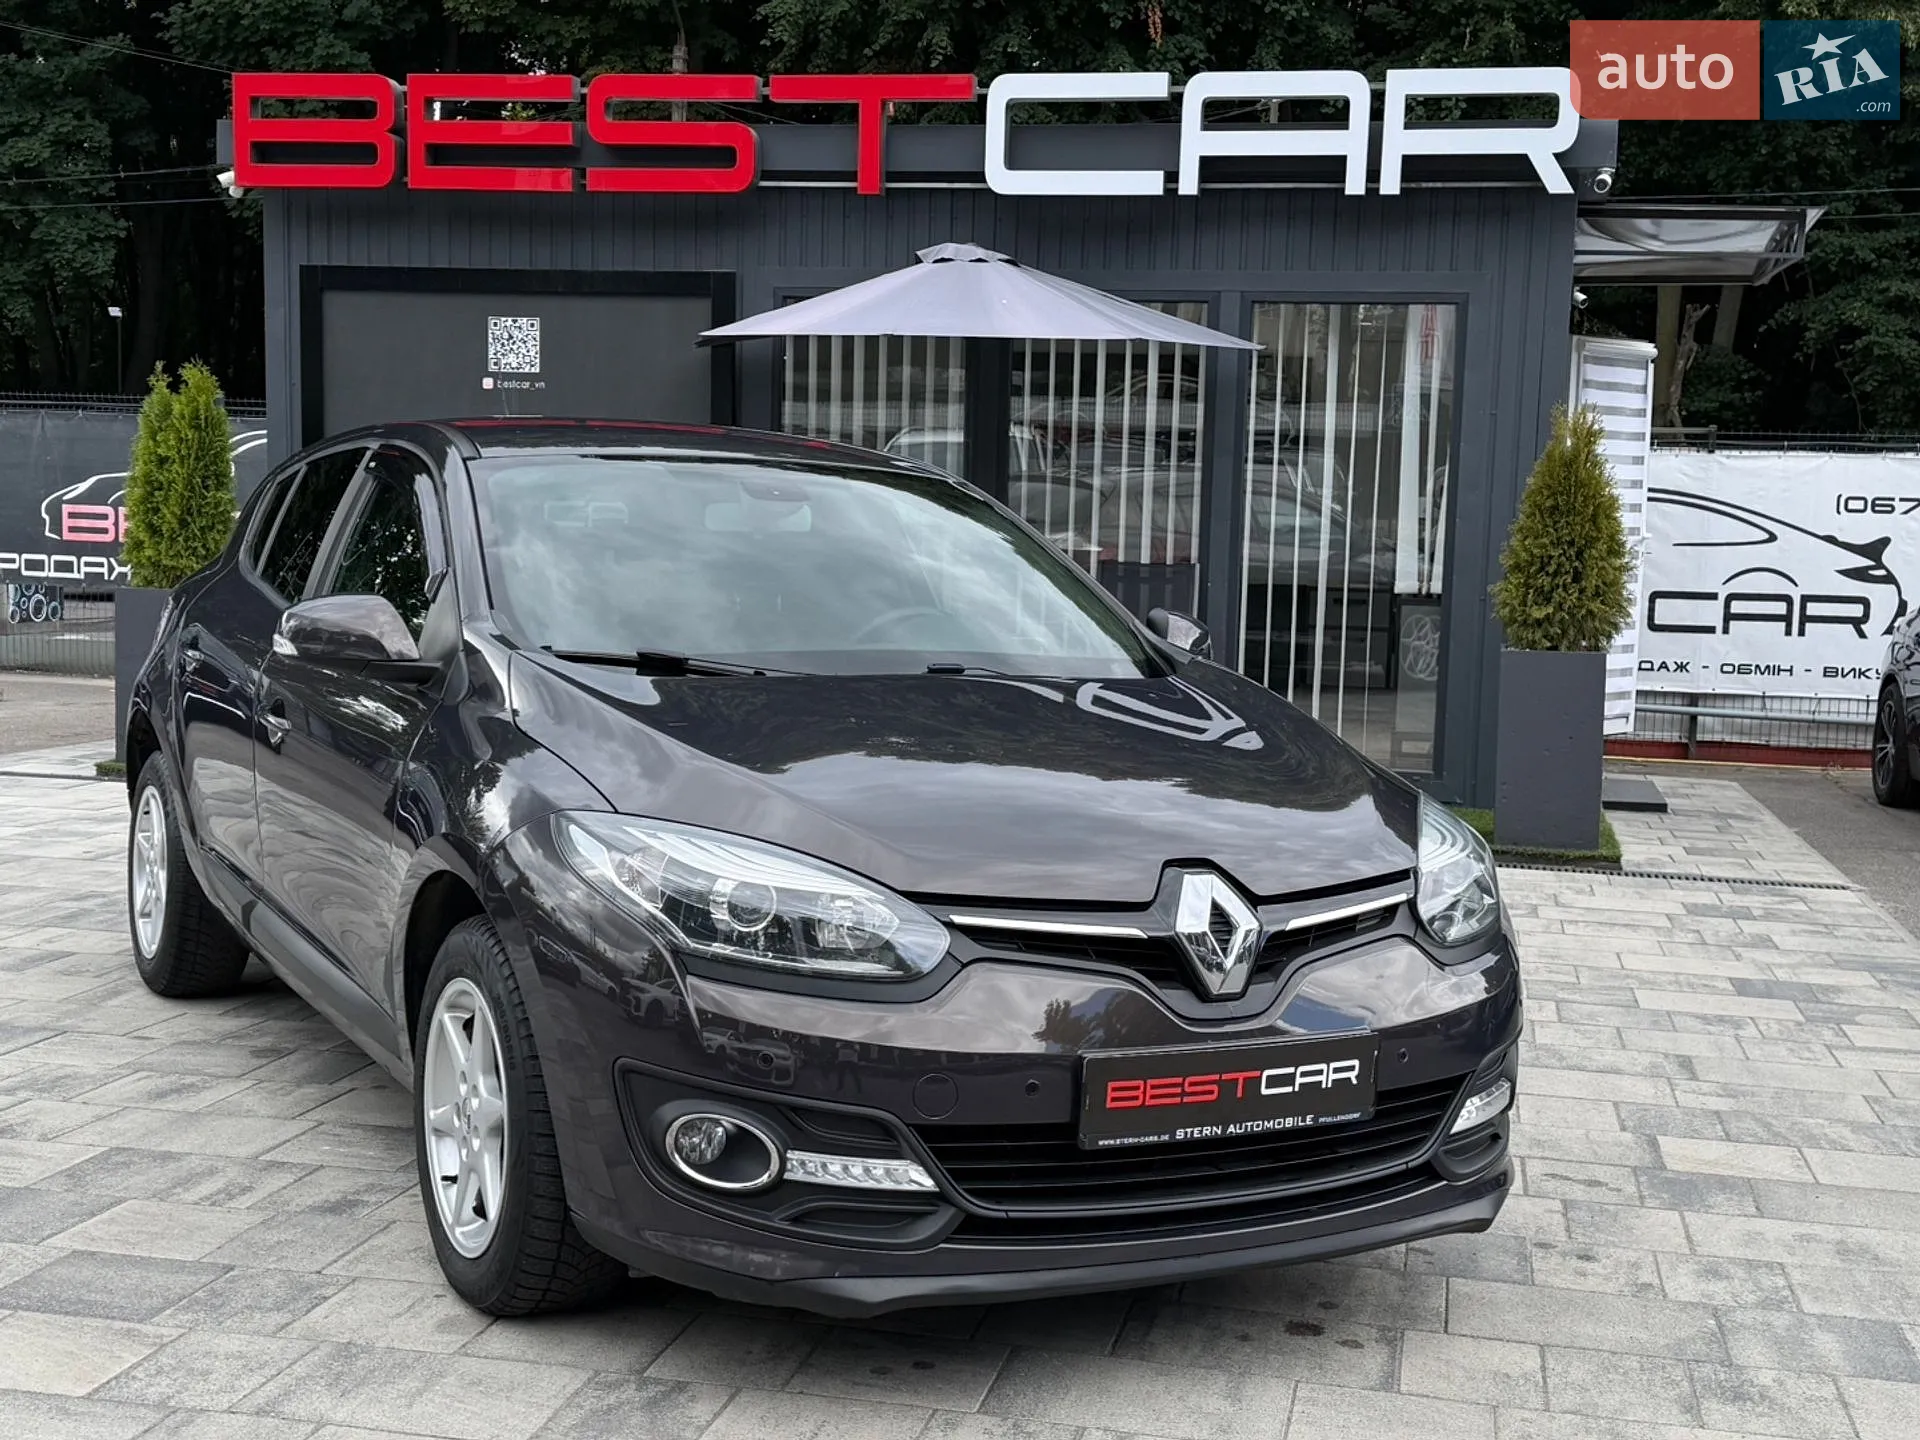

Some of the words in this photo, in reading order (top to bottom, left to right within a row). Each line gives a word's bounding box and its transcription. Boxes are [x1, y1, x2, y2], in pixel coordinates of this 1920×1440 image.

[1647, 590, 1871, 639] CAR
[1720, 662, 1793, 677] ОБМІН
[1175, 1125, 1222, 1140] STERN
[1226, 1114, 1315, 1135] AUTOMOBILE
